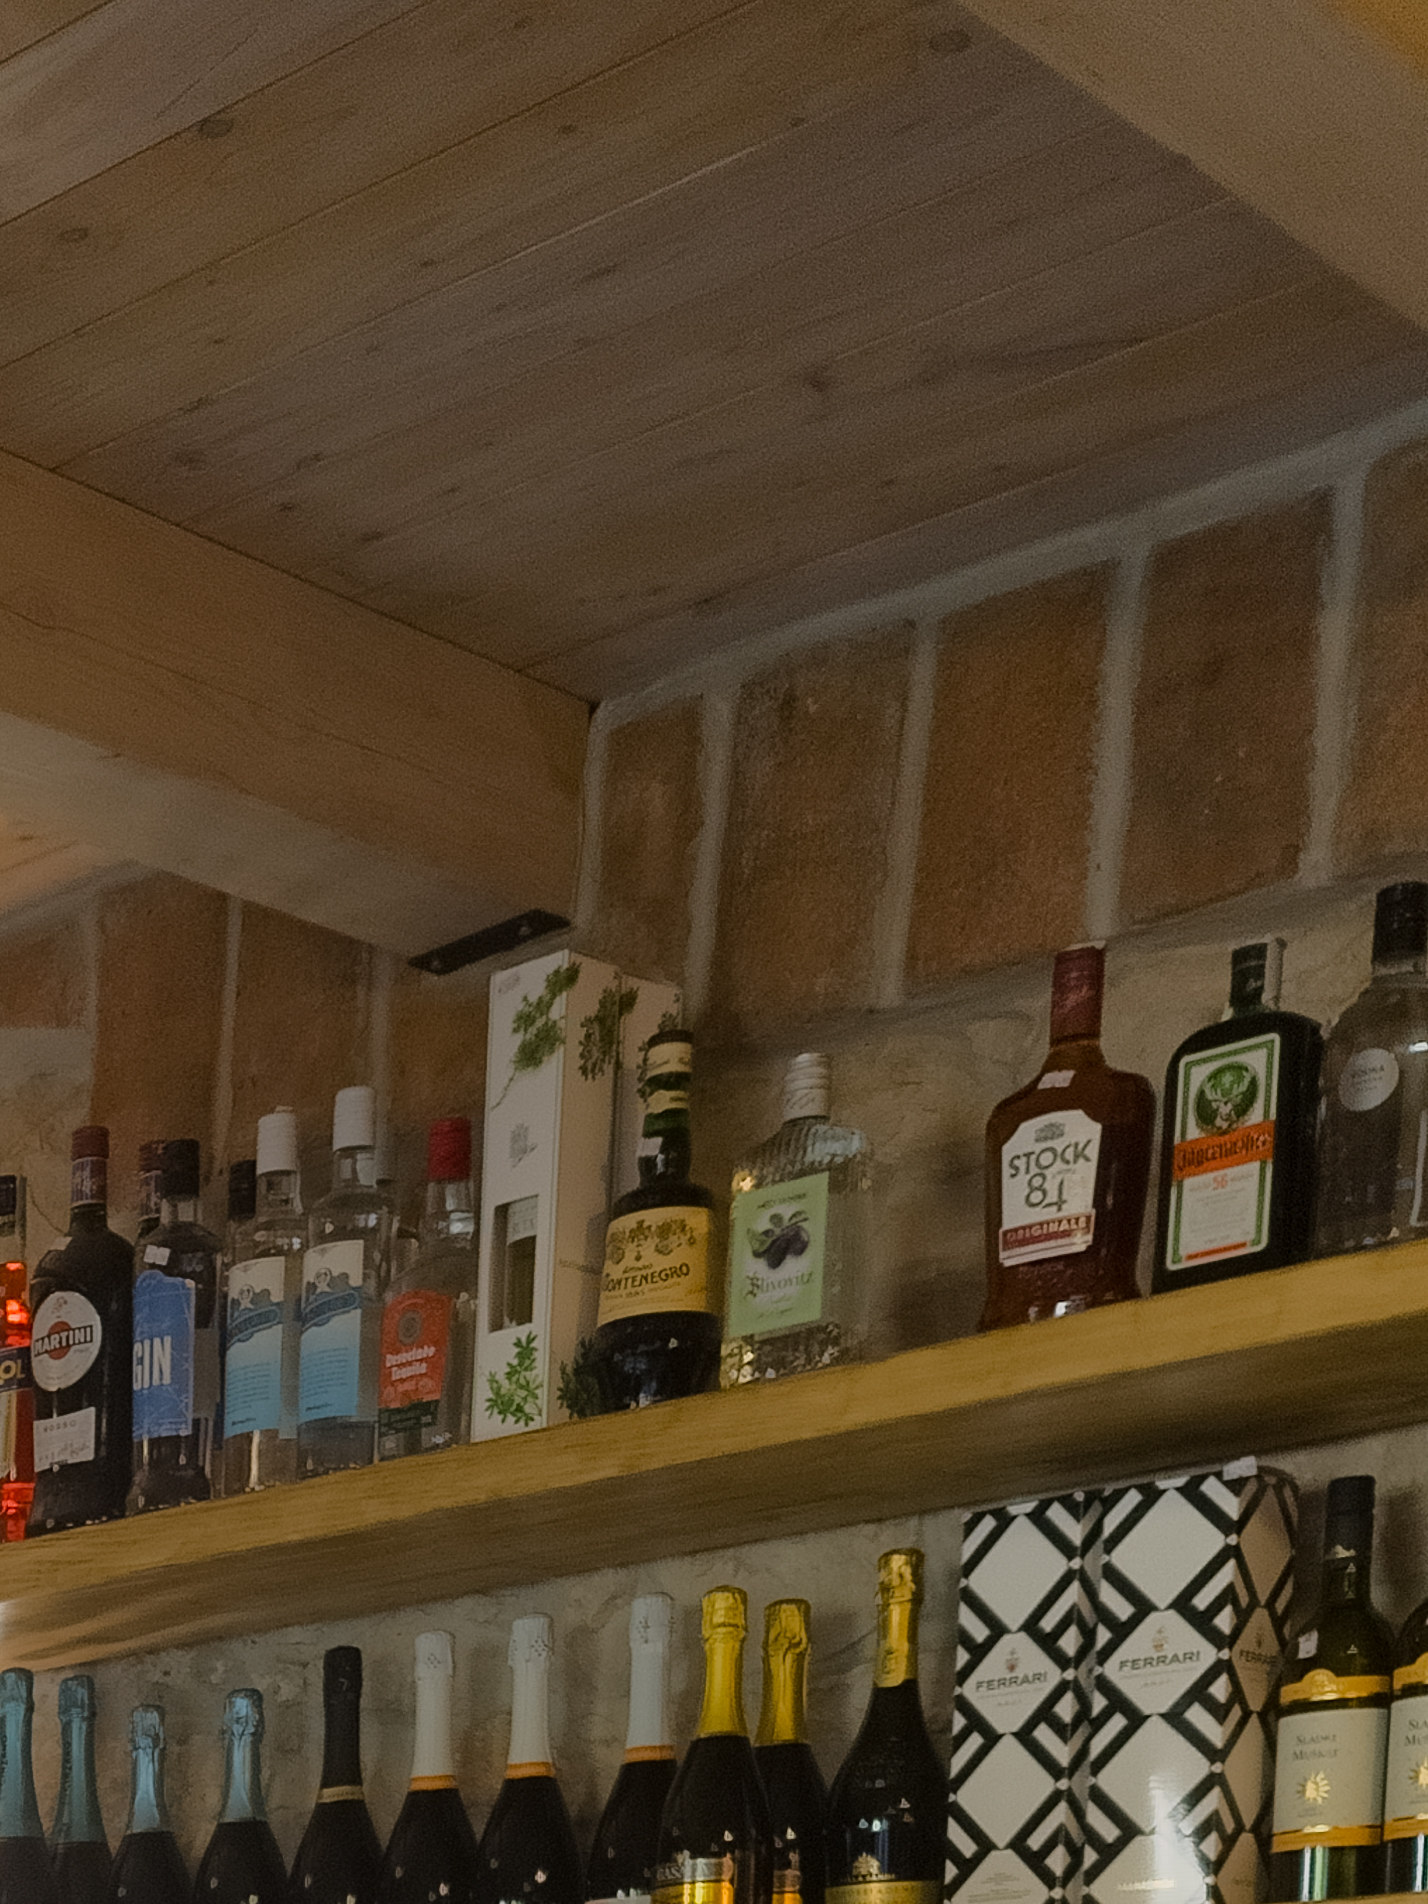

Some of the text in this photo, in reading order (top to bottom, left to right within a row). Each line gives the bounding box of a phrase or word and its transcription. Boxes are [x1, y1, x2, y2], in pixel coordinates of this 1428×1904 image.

[1009, 1140, 1092, 1178] STOCK
[1025, 1173, 1066, 1212] 84
[1006, 1216, 1087, 1242] ORIGINALE
[35, 1325, 93, 1356] MARTINI
[133, 1336, 171, 1391] GIN
[1118, 1650, 1201, 1673] FERRARI
[975, 1671, 1049, 1692] FERRARI
